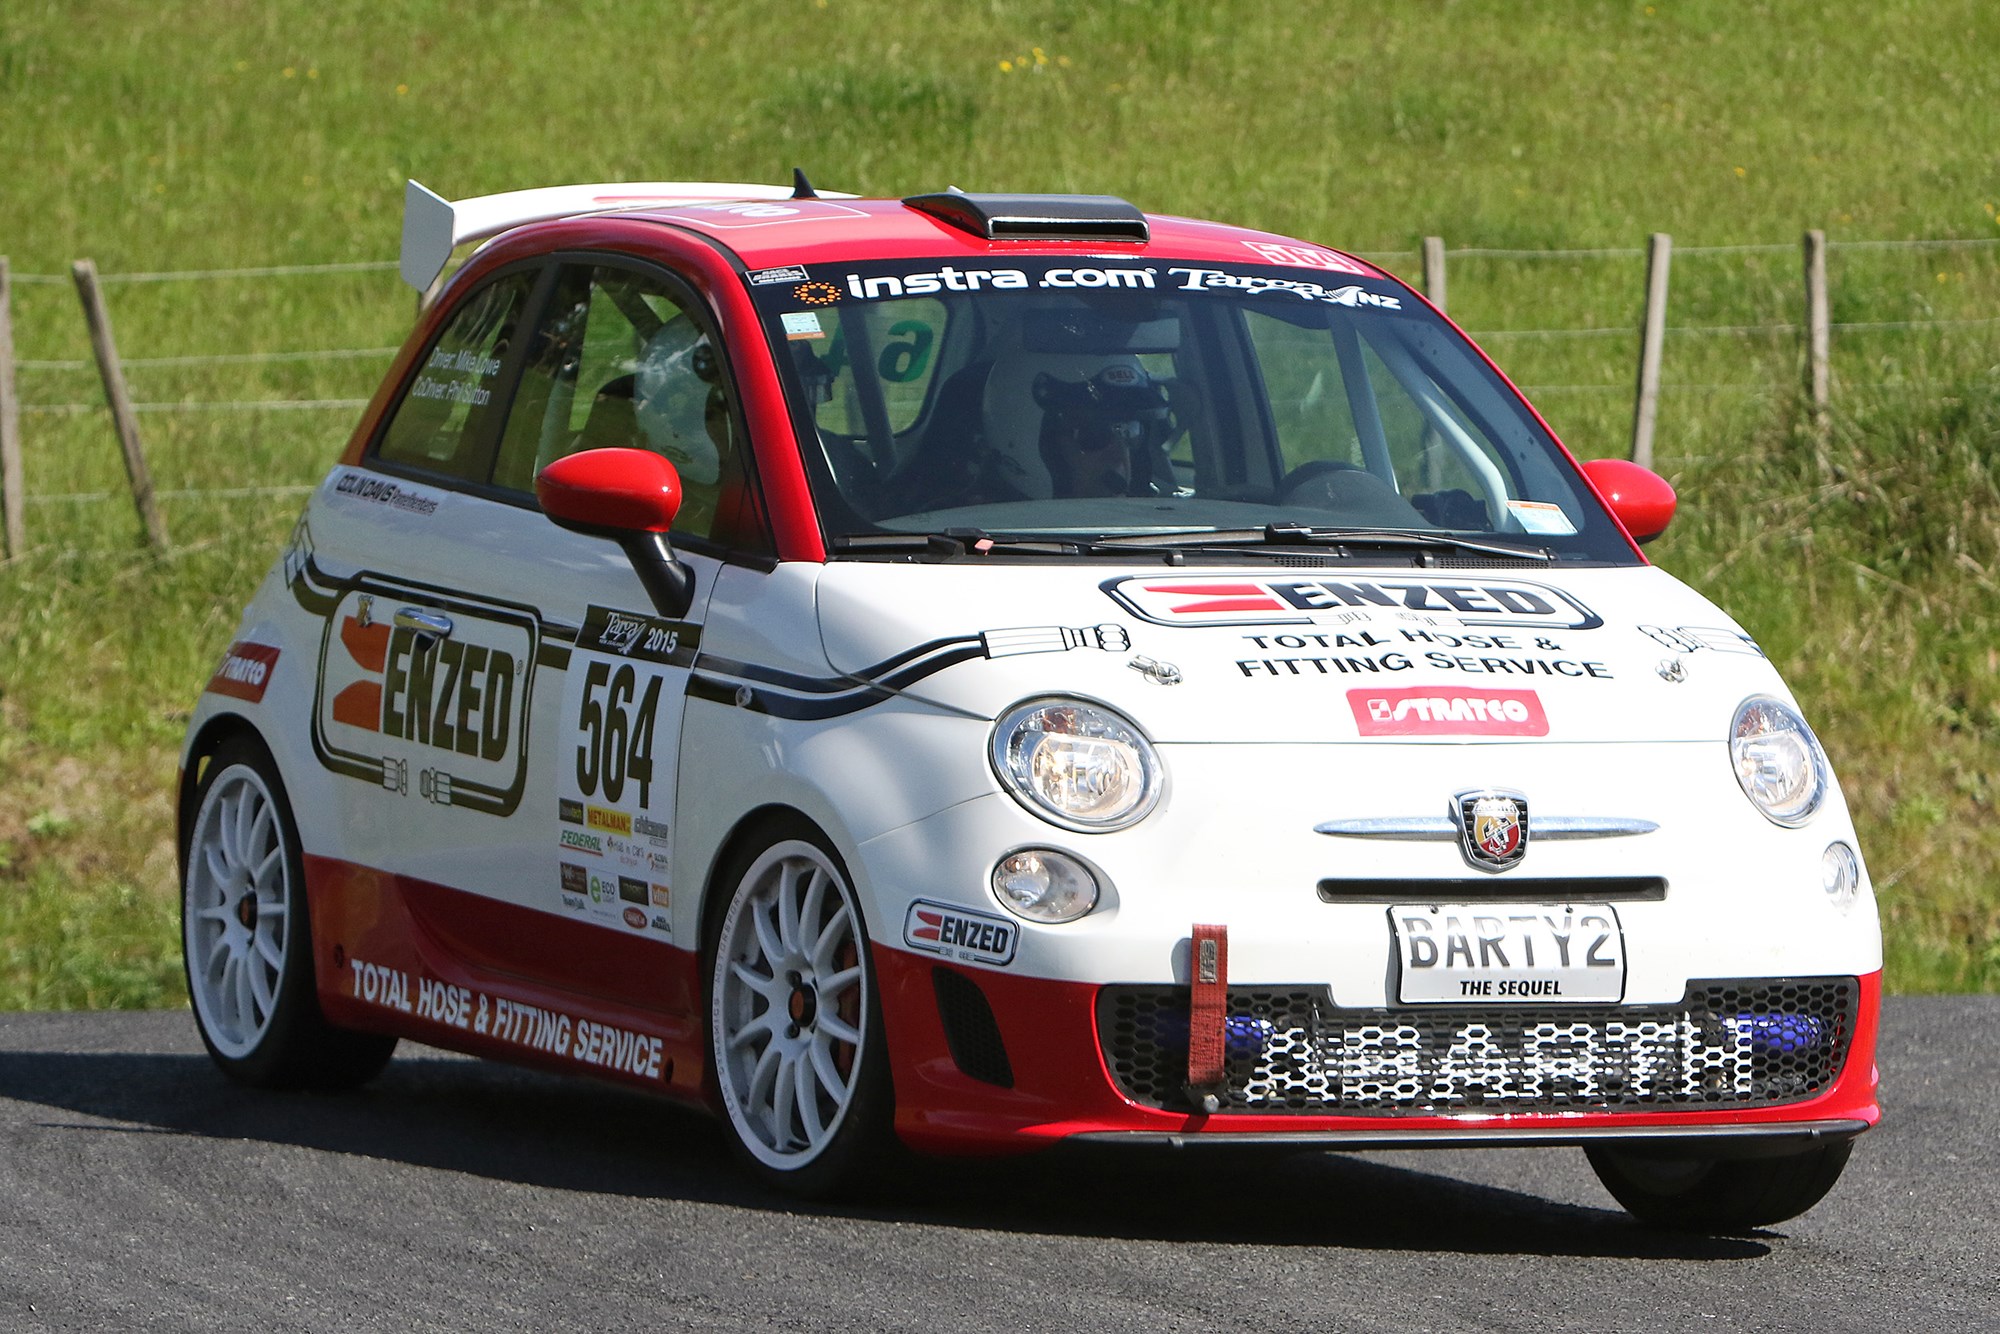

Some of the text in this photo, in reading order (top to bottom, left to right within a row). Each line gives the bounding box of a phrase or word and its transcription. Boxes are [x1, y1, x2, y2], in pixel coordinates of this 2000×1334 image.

[1248, 242, 1354, 271] 564
[1168, 267, 1401, 309] Targa NZ
[1265, 582, 1556, 614] ENZED
[599, 611, 679, 654] Targa 2015
[1242, 628, 1566, 651] TOTAL HOSE &
[1235, 652, 1614, 679] FITTING SERVICE
[383, 627, 514, 762] ENZED
[1392, 697, 1529, 722] STRATCO
[576, 660, 664, 810] 564
[588, 807, 627, 832] METALMAN
[561, 829, 602, 851] FEDERAL
[602, 881, 615, 895] ECO
[715, 888, 743, 983] MOTORSPORT
[940, 915, 1008, 954] ENZED
[1402, 916, 1616, 968] BARTY2
[1460, 980, 1562, 997] THE SEQUEL
[351, 958, 663, 1080] TOTAL HOSE & FITTING SERVICE
